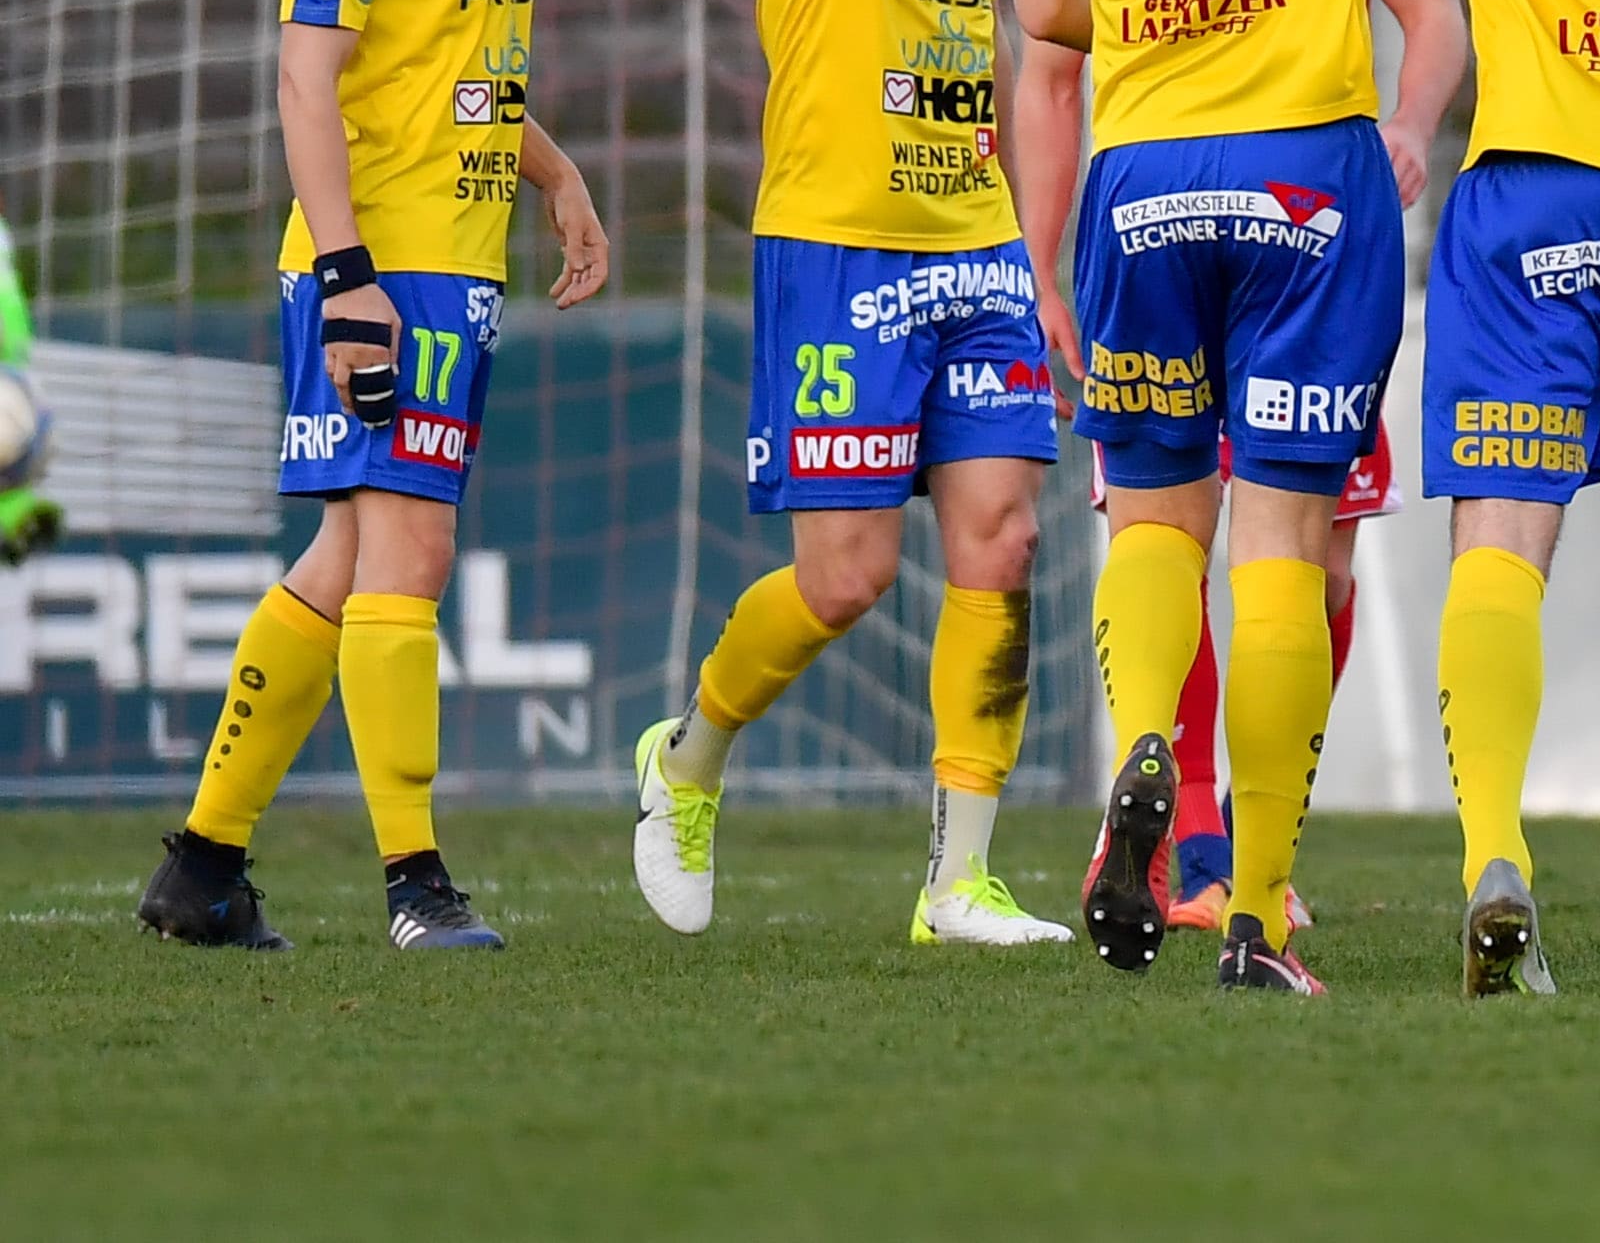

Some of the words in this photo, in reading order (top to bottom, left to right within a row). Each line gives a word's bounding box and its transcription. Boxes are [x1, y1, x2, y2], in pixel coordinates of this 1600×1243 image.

[891, 140, 973, 171] WIENER
[1121, 195, 1256, 225] KFZ-TANKSTELLE
[412, 326, 463, 405] 17
[794, 343, 857, 419] 25
[1083, 374, 1214, 419] GRUBER
[0, 551, 592, 690] REL
